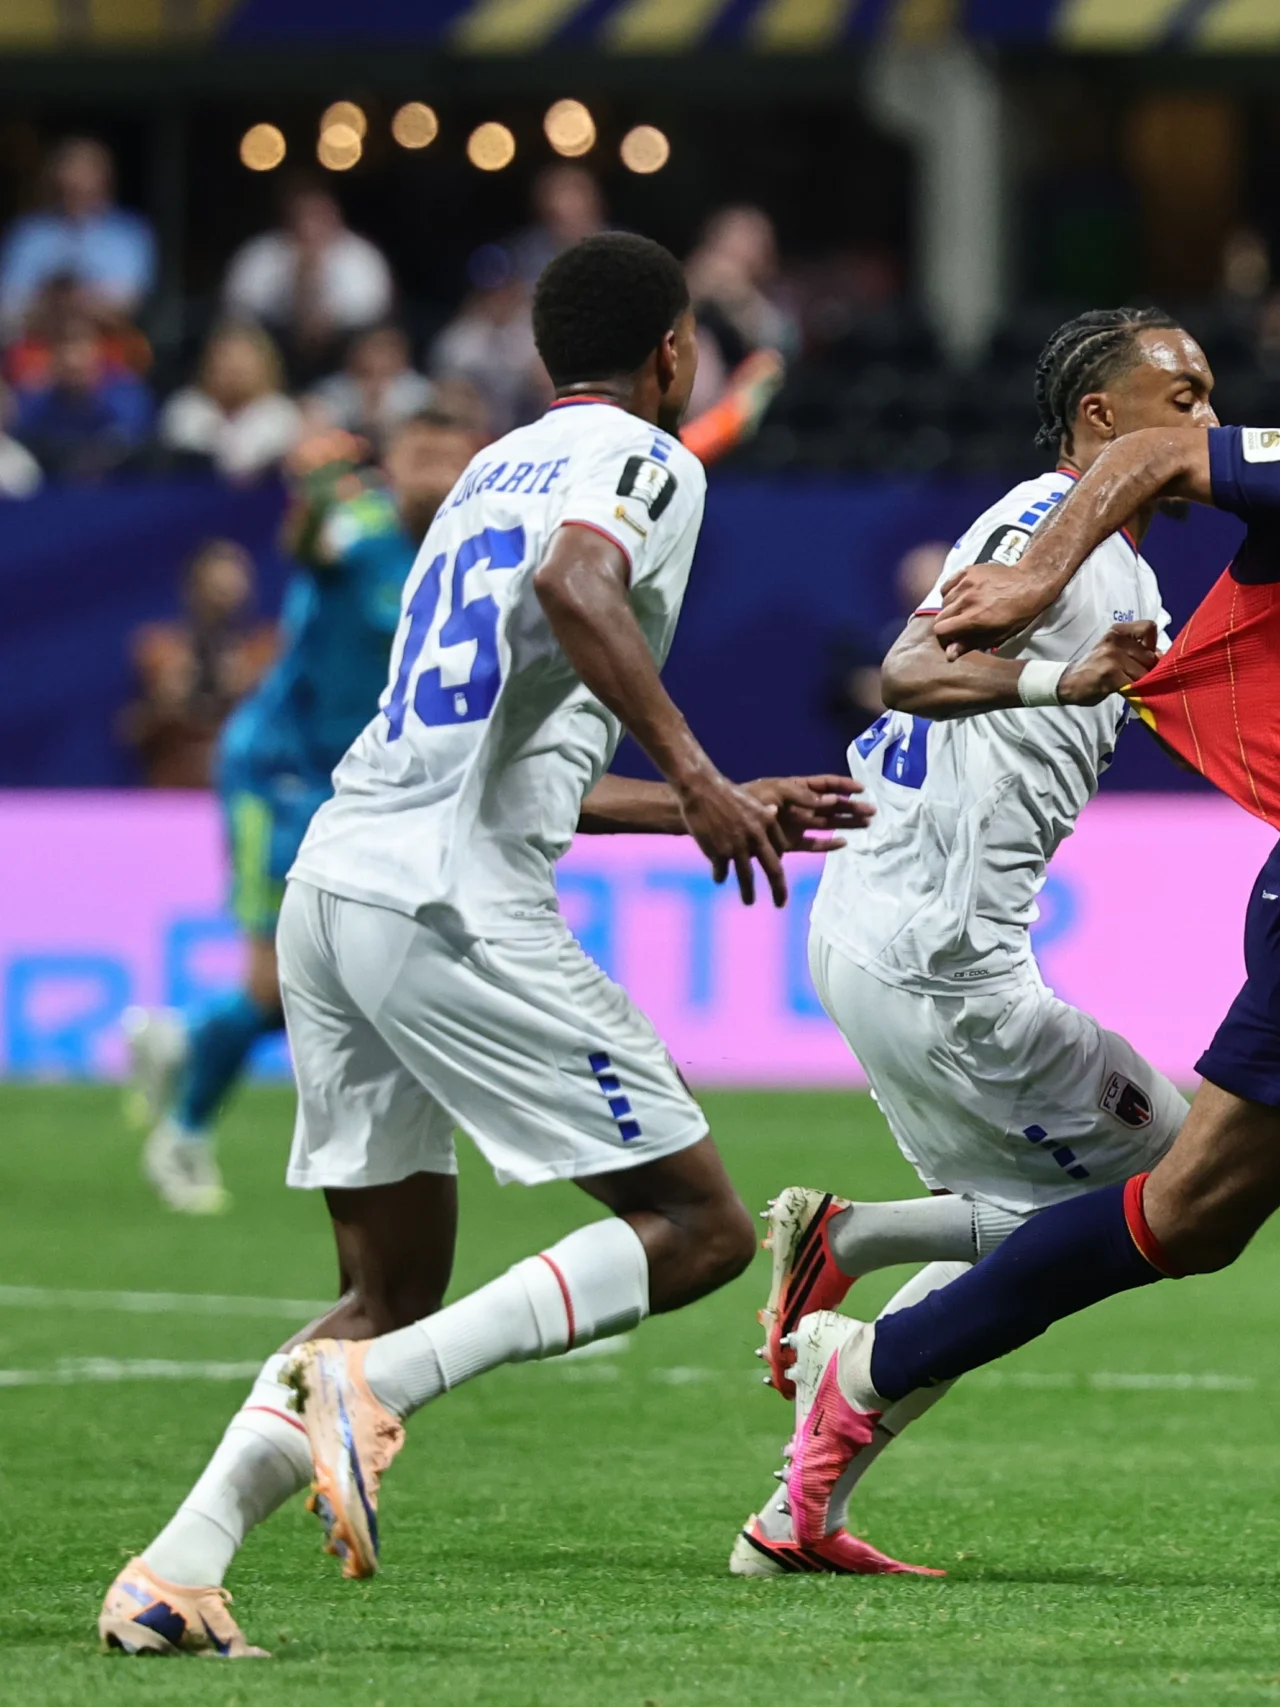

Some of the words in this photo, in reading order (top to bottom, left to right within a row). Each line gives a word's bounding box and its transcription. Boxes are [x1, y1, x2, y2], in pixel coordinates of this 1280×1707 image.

[451, 456, 570, 508] DUARTE
[382, 523, 525, 742] 15
[1103, 1076, 1120, 1110] FCF
